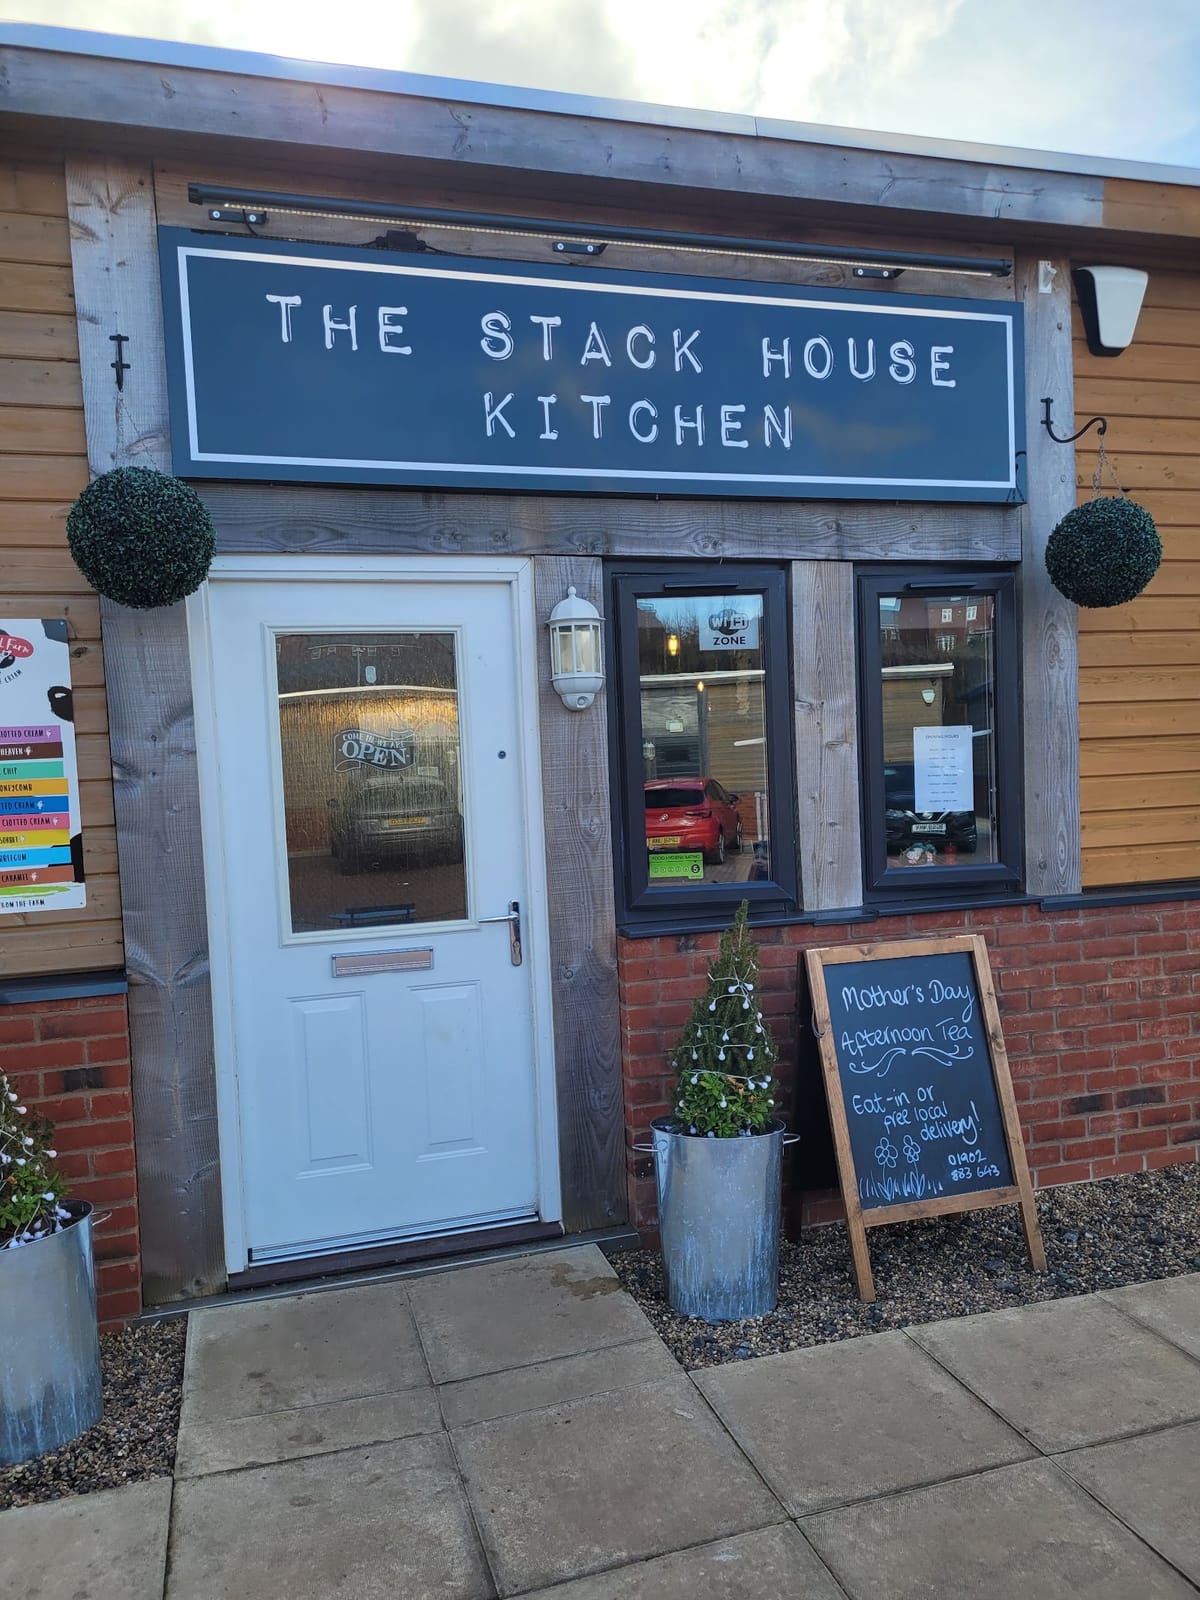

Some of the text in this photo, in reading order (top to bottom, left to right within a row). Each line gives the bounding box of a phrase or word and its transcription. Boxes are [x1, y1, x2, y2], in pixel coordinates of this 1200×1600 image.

[265, 294, 957, 389] THE STACK HOUSE
[483, 391, 794, 450] KITCHEN
[713, 636, 747, 646] ZONE
[0, 729, 44, 738] LOTTED CREAM
[342, 732, 364, 741] COME
[342, 740, 407, 766] OPEN
[3, 767, 17, 776] CHIP
[0, 783, 33, 793] ONEYCOMB
[14, 801, 35, 810] CREAM
[2, 817, 51, 827] CLOTTED CREAM
[2, 873, 29, 883] CARAMEL
[28, 898, 46, 907] FARM
[841, 979, 976, 1023] Mother's Day
[841, 1017, 974, 1057] Afternoon Tea
[917, 1085, 934, 1102] or
[884, 1101, 949, 1135] free local
[920, 1100, 983, 1146] delivery!
[948, 1149, 988, 1166] 01902
[950, 1164, 1001, 1182] 883 643
